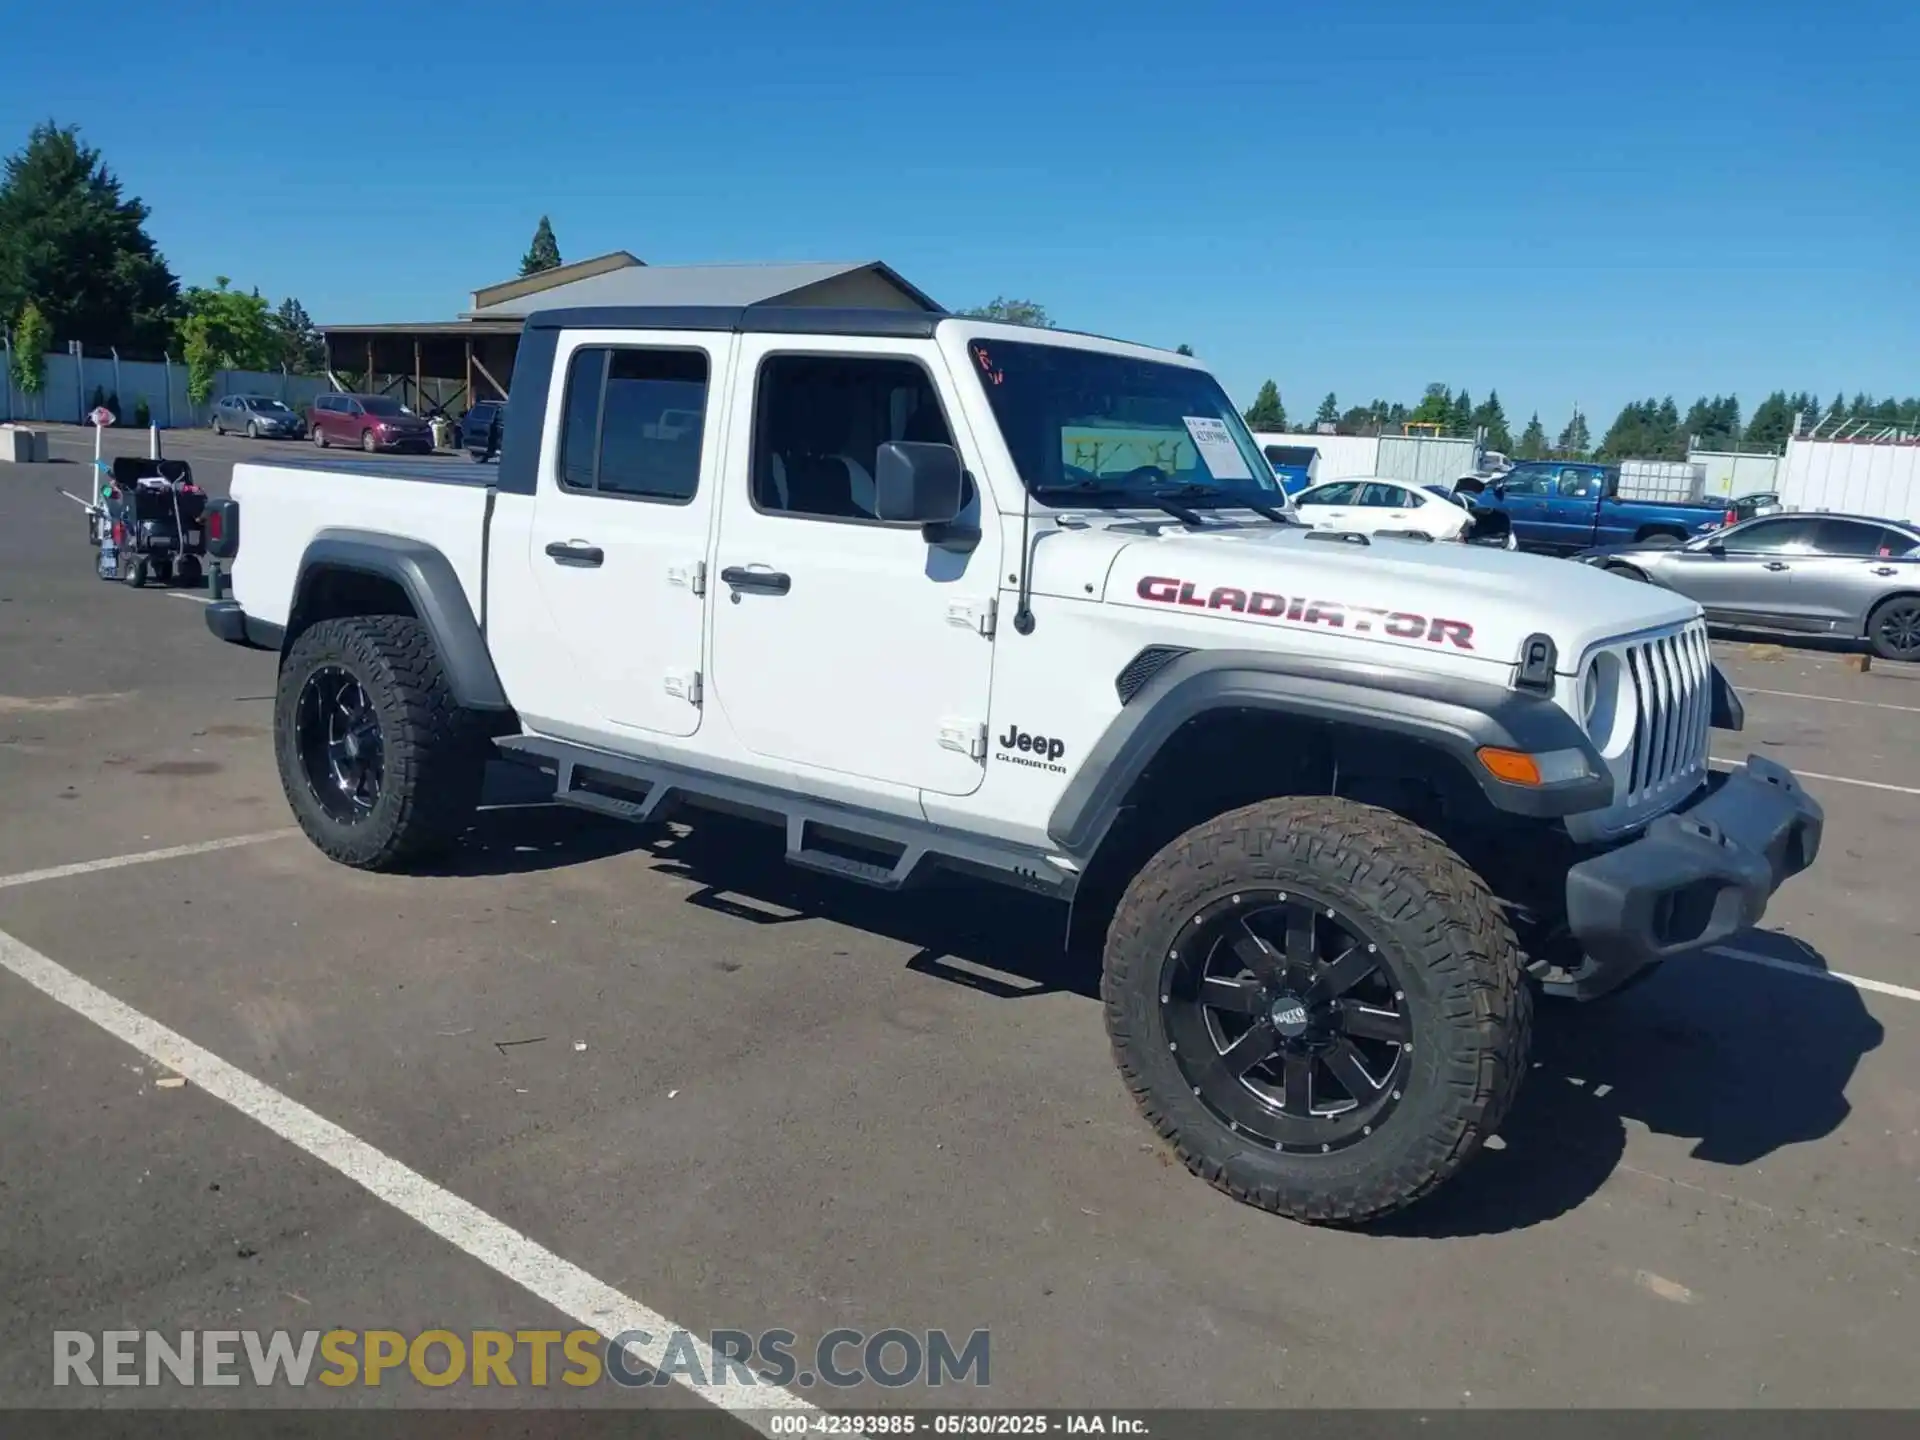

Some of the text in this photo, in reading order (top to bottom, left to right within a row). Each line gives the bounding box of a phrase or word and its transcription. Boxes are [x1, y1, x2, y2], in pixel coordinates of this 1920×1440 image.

[1136, 575, 1475, 650] GLADIATOR
[999, 724, 1065, 762] Jeep
[995, 752, 1067, 774] GLADIATOR
